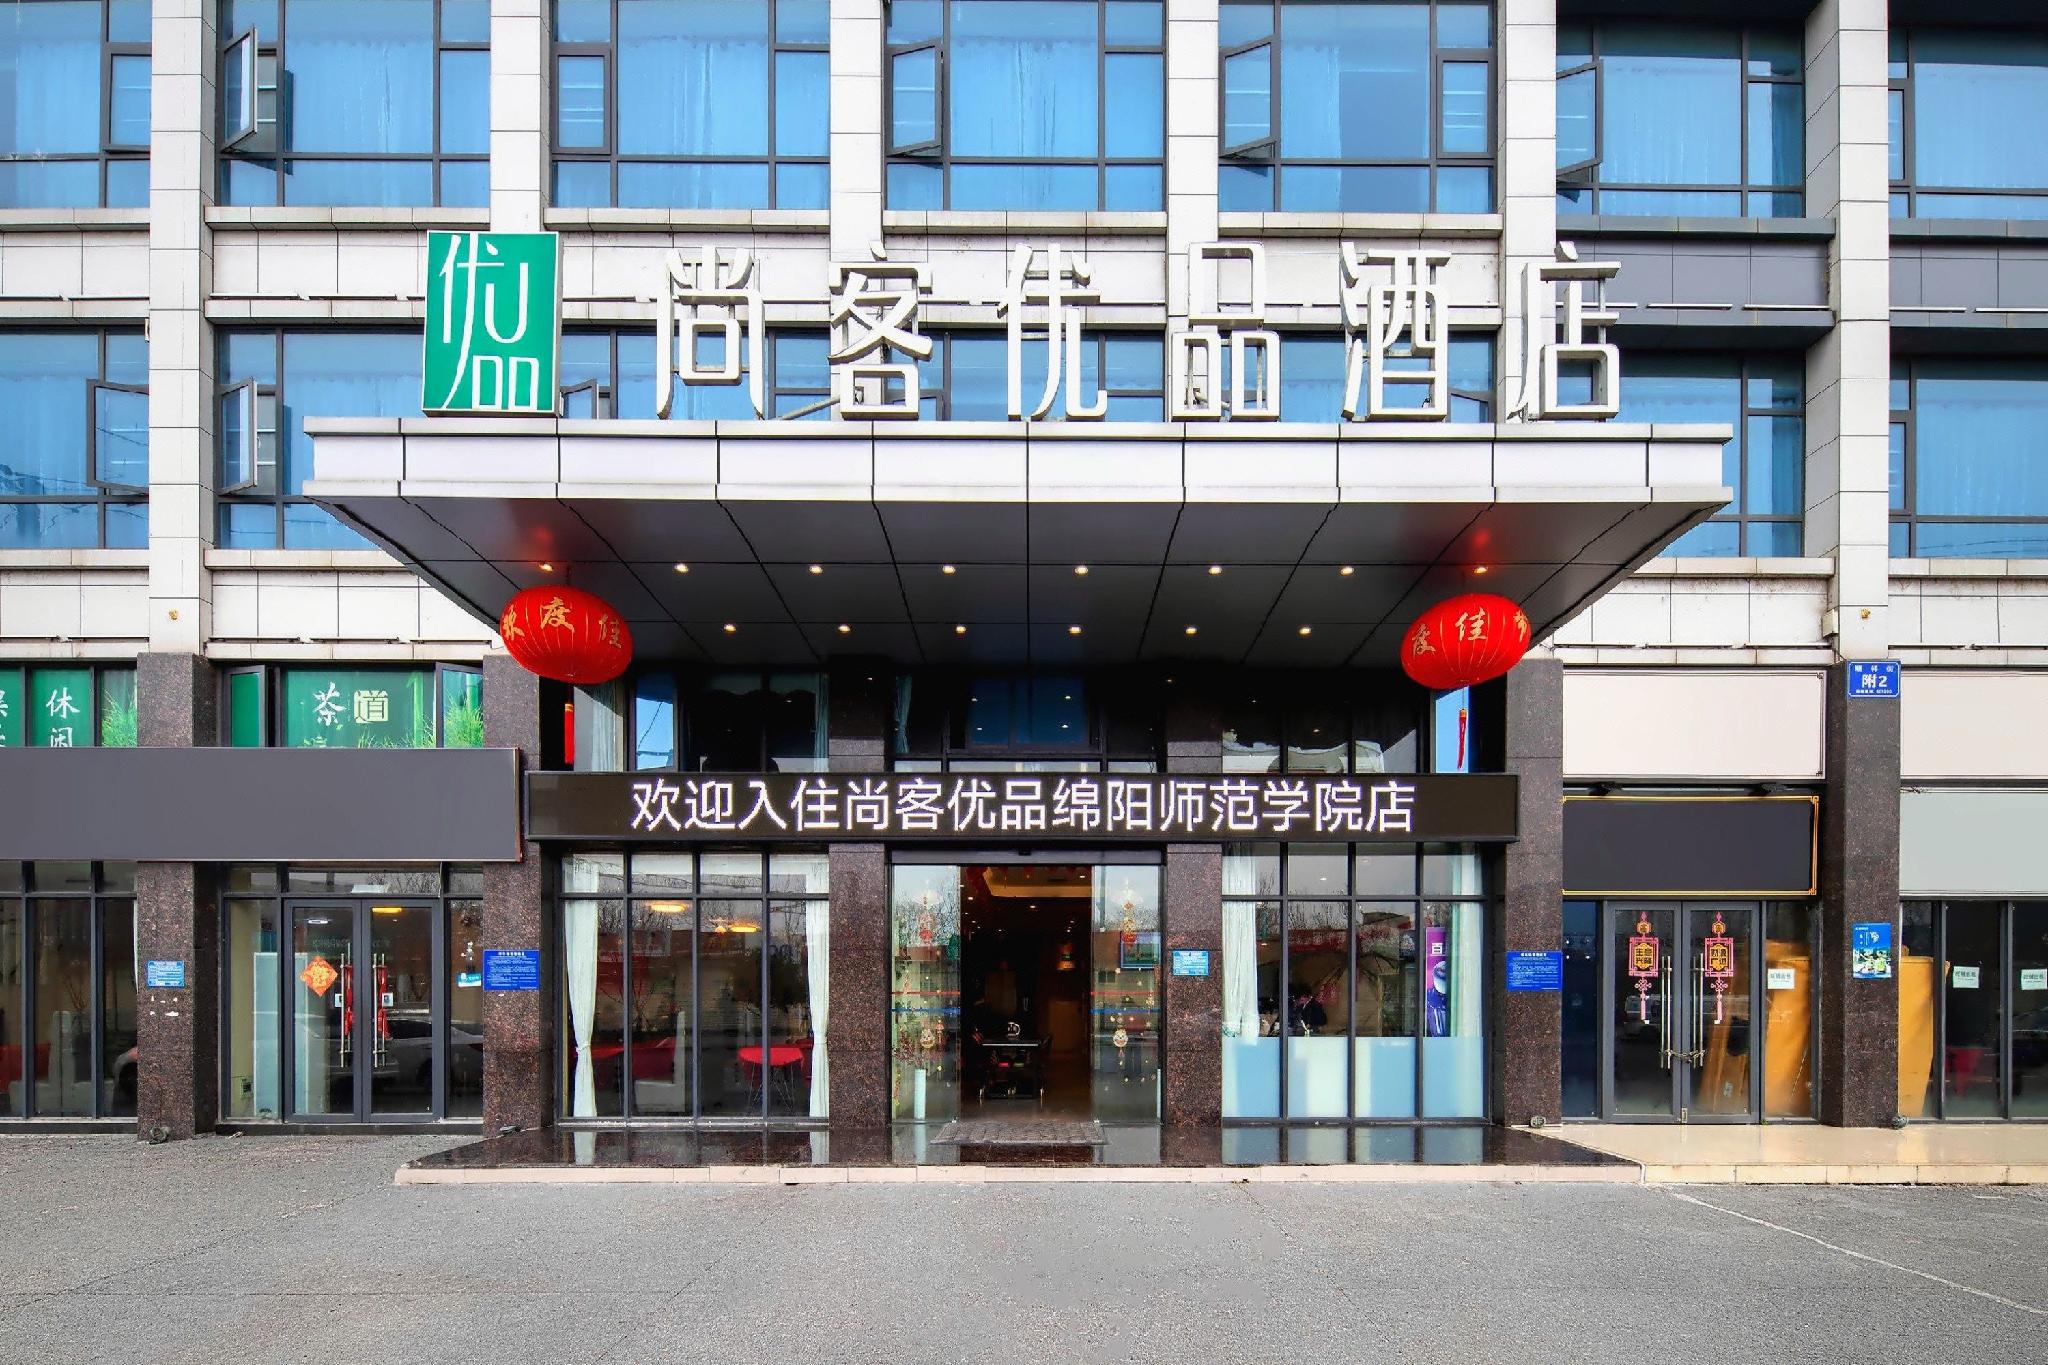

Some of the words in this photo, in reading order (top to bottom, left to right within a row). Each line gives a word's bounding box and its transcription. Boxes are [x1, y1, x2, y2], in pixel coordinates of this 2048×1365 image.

[656, 239, 1622, 421] 尚客优品酒店
[630, 778, 1416, 833] 欢迎入住尚客优品绵阳师范学院店
